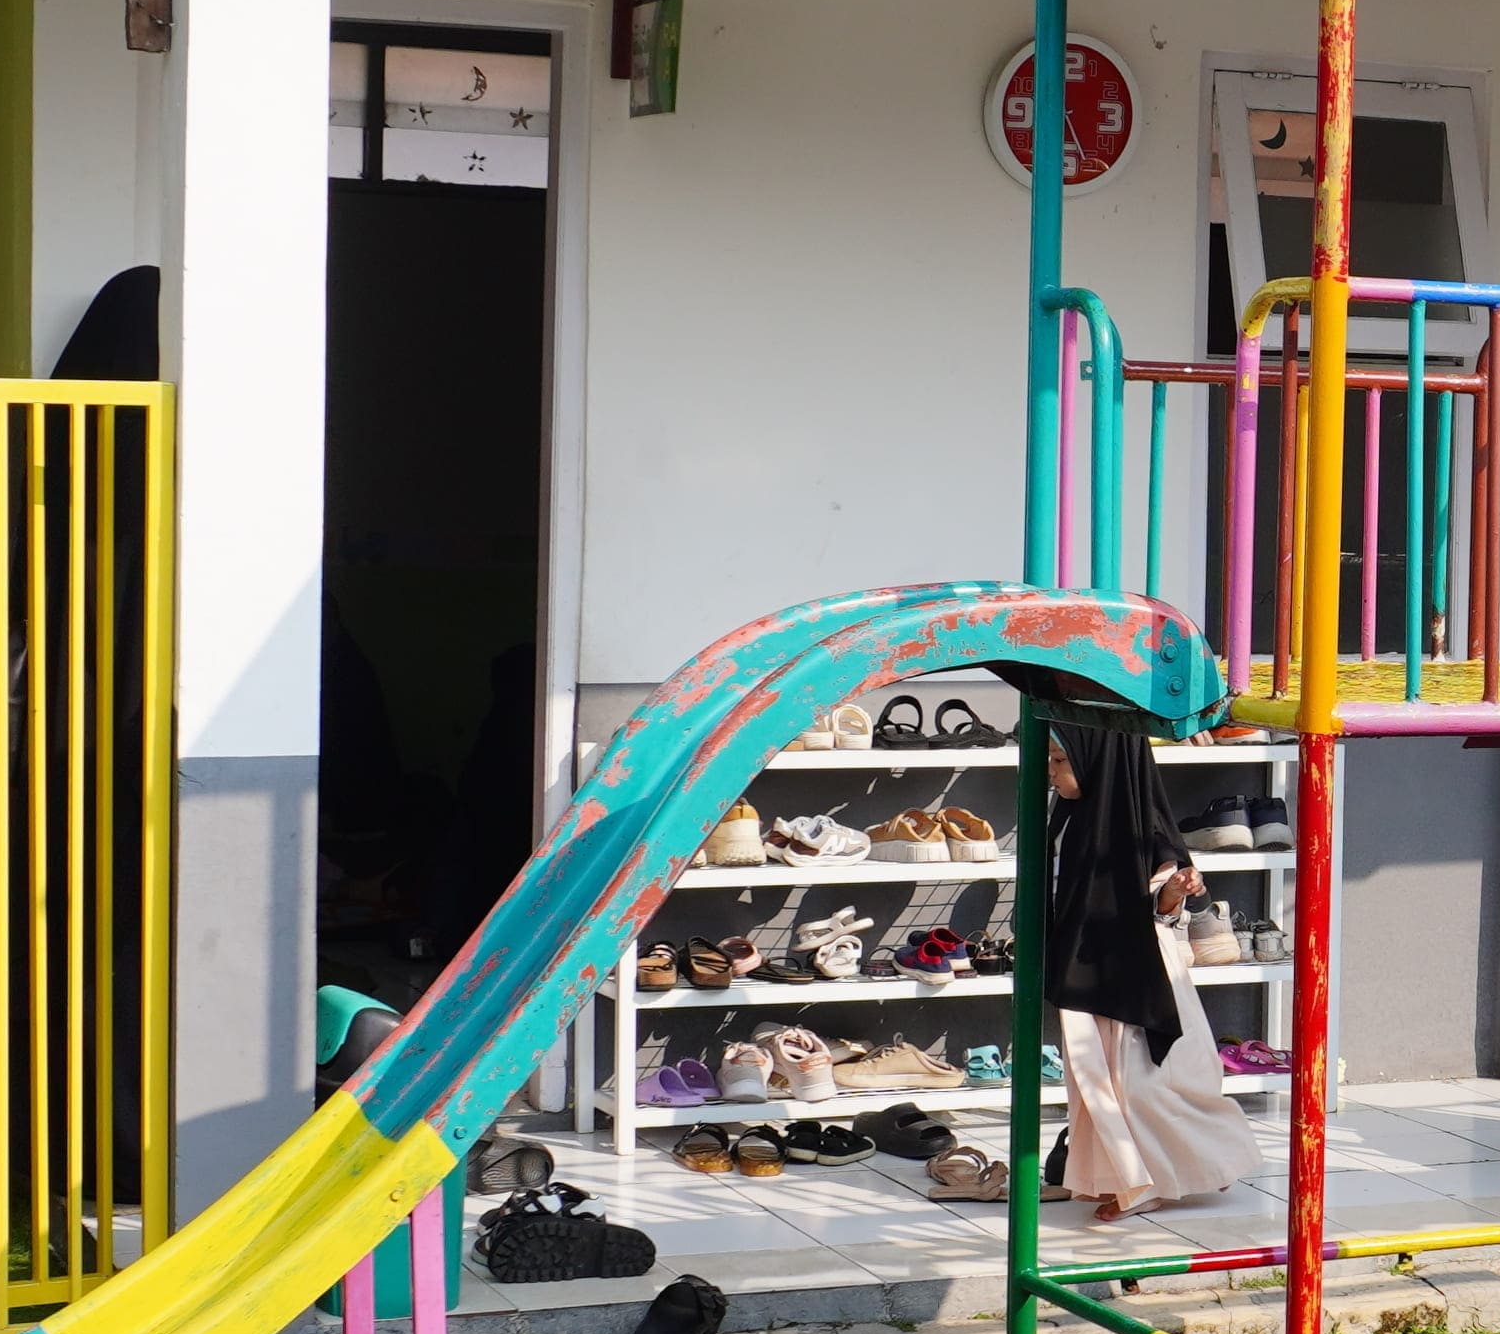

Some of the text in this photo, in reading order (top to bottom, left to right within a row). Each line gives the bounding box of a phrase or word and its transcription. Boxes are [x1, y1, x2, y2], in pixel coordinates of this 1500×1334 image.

[1089, 59, 1098, 77] 1
[1103, 81, 1119, 100] 2
[1005, 96, 1034, 129] 9
[1097, 101, 1124, 134] 3
[1097, 135, 1114, 154] 4
